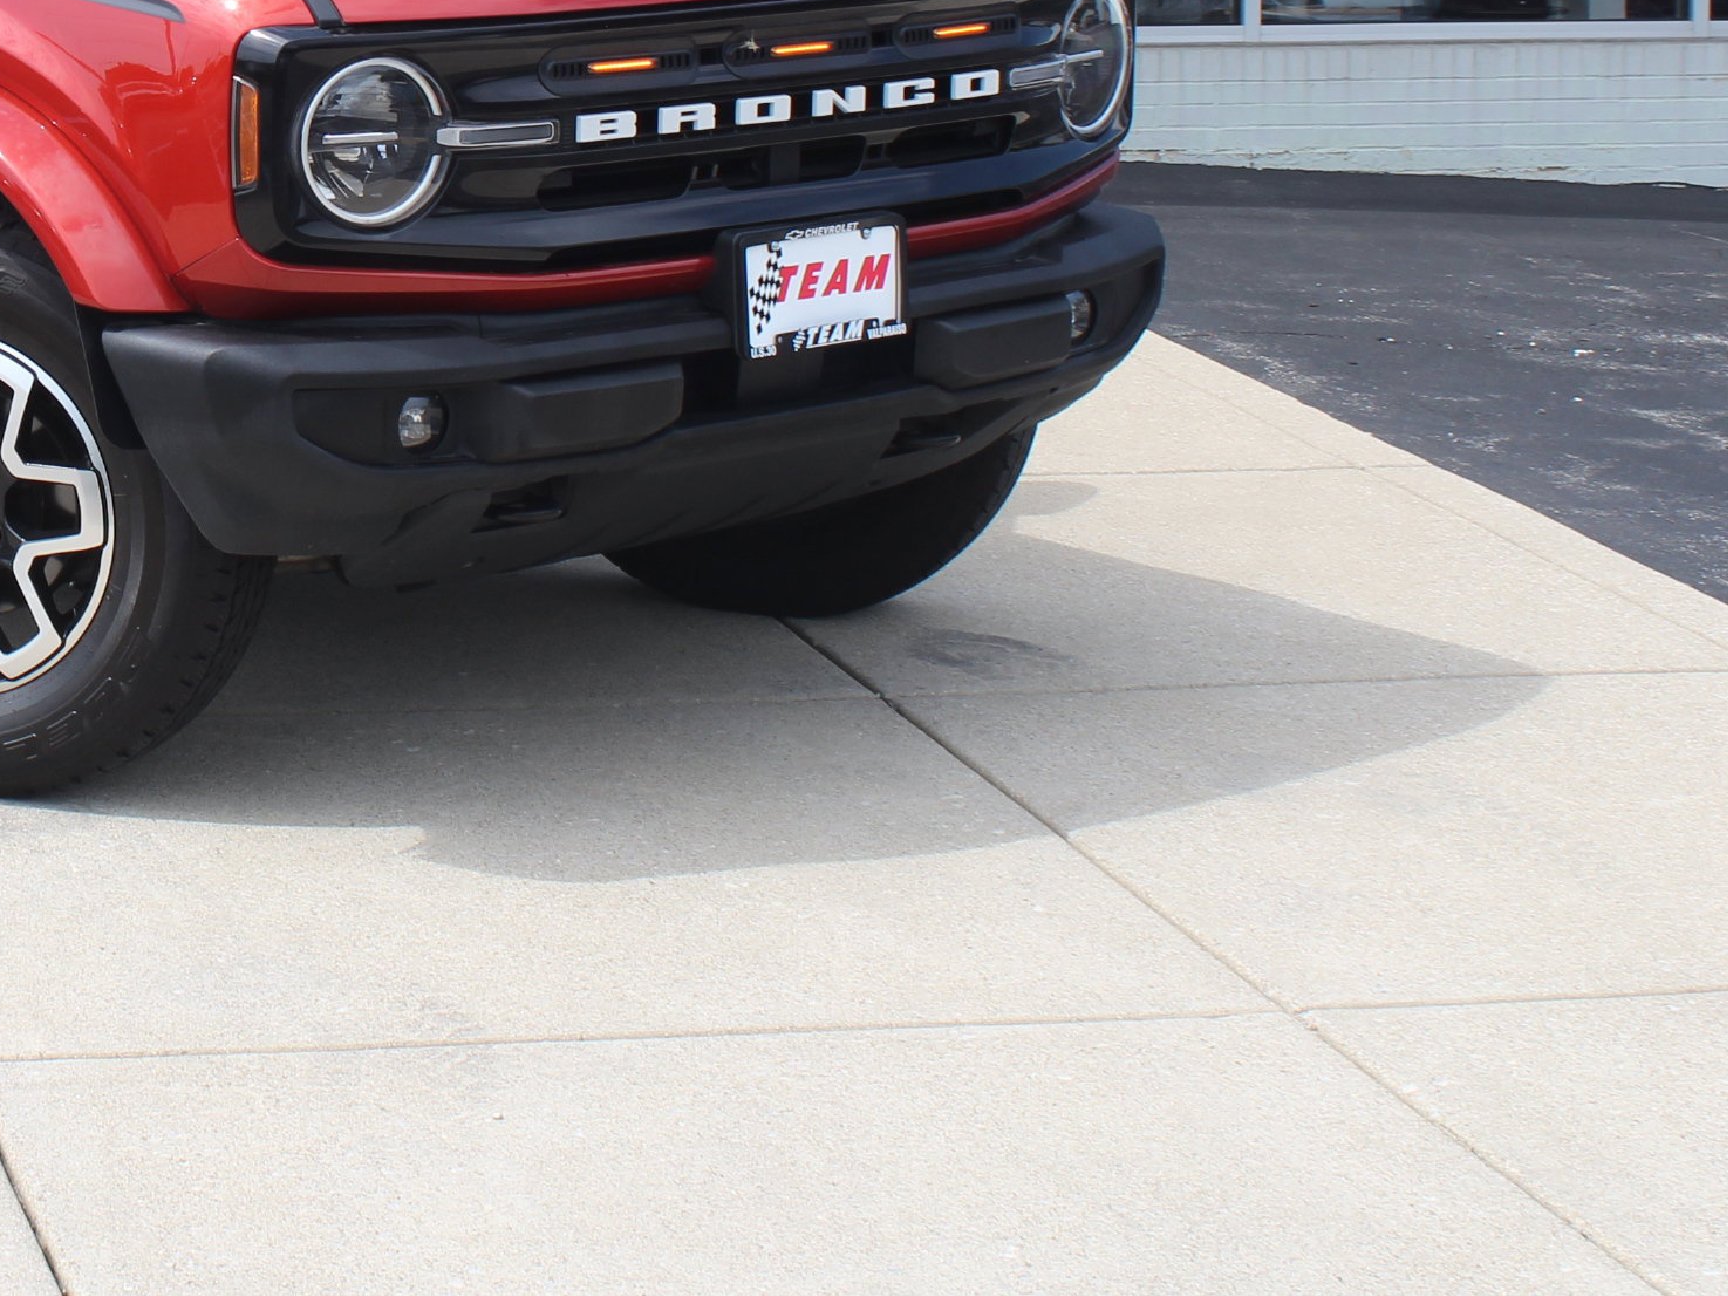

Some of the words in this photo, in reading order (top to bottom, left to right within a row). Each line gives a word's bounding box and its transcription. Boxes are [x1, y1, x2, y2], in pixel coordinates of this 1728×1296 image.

[575, 68, 1000, 144] BRONCO
[804, 222, 860, 239] CHEVROLET
[777, 253, 892, 303] TEAM
[806, 319, 866, 347] TEAM
